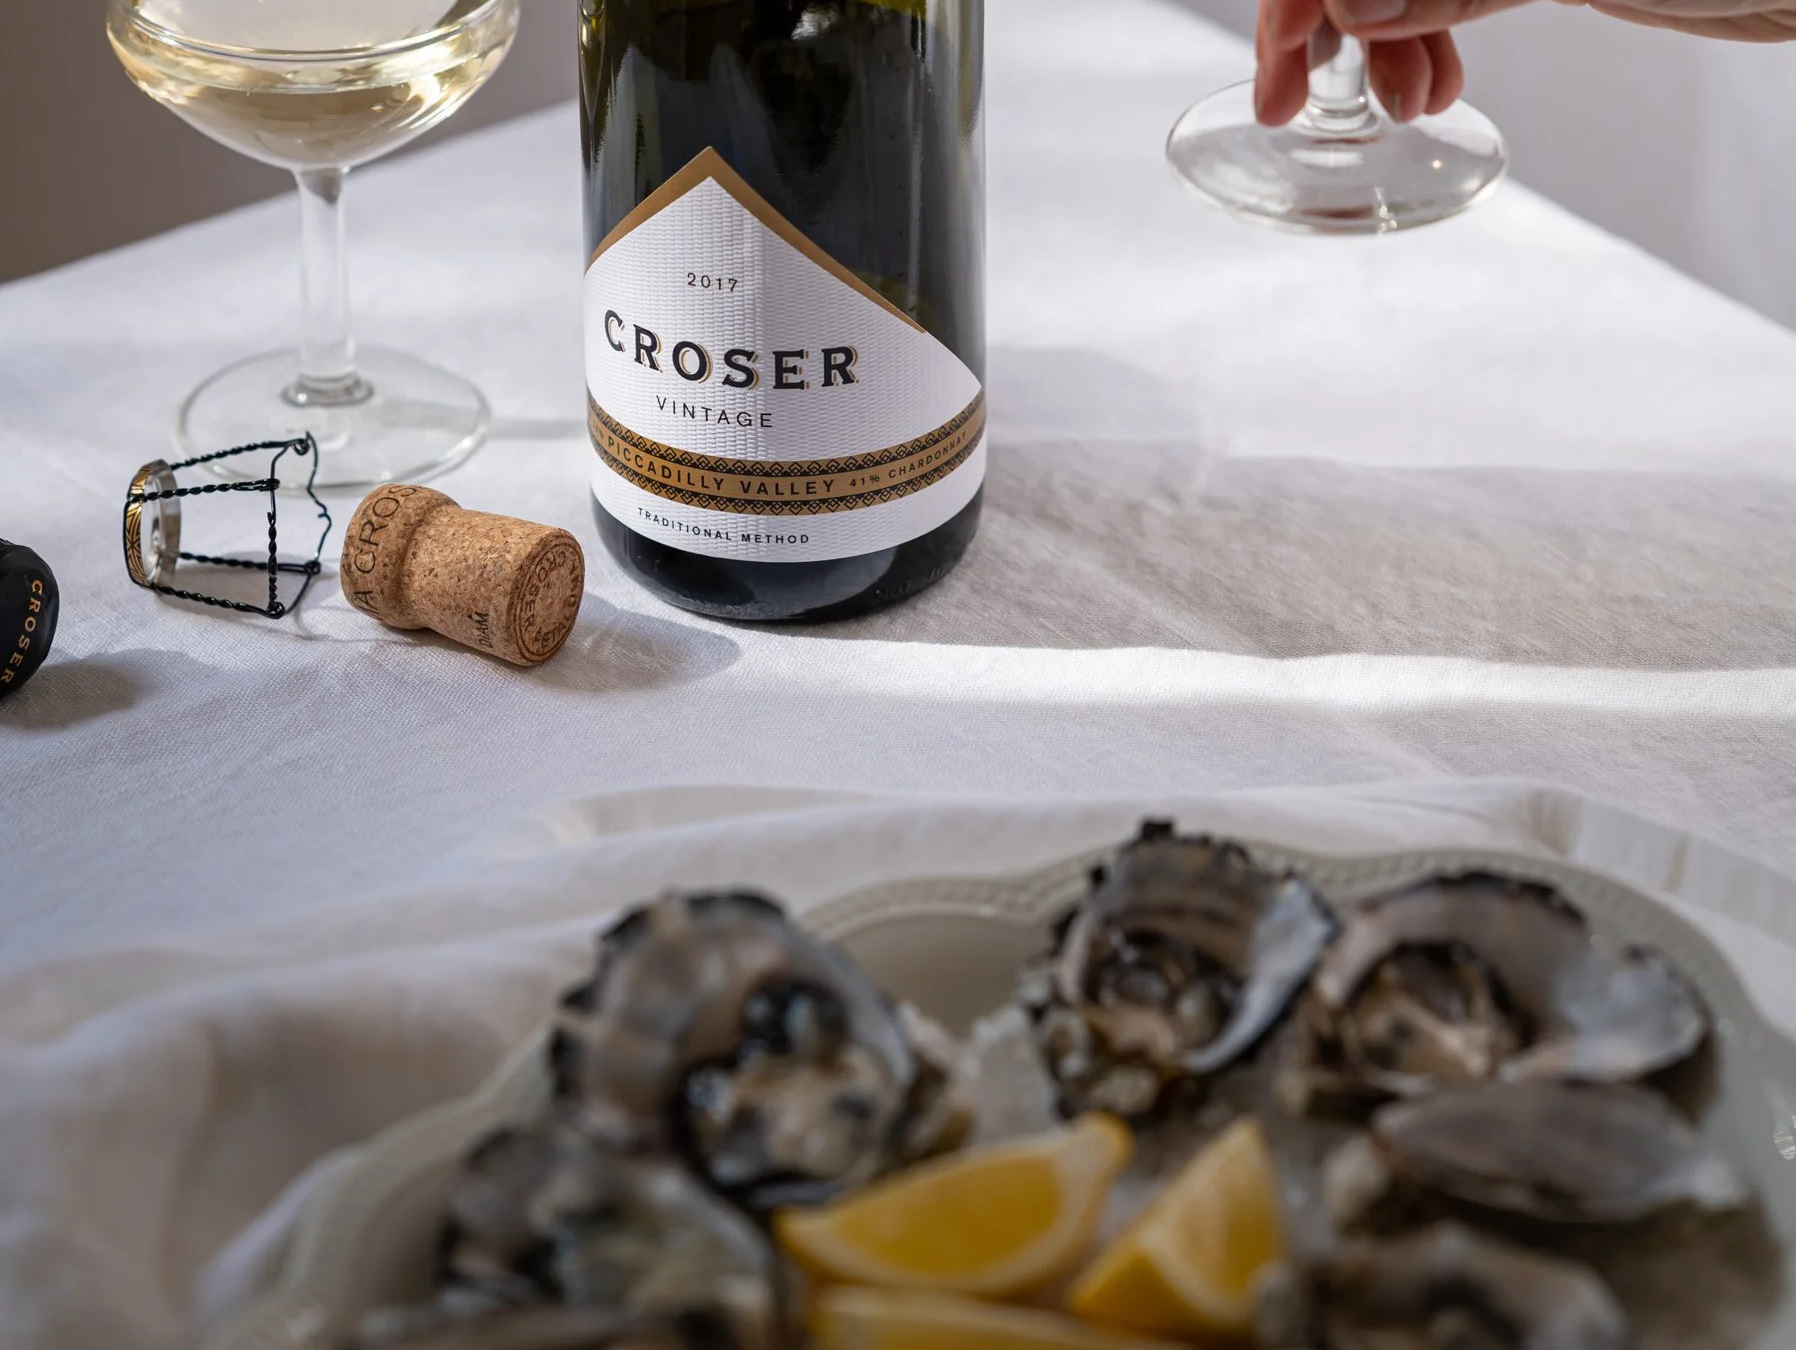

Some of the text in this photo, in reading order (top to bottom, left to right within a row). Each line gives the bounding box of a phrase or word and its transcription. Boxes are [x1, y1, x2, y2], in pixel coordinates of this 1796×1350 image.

[686, 272, 738, 293] 2017
[604, 309, 859, 391] CROSER
[656, 395, 773, 429] VINTAGE
[608, 432, 967, 496] PICCADILLY VALLEY 41% CHARDONNAY
[354, 486, 418, 574] CROS
[637, 507, 810, 545] TRADITIONAL METHOD
[0, 579, 43, 684] CROSER
[474, 611, 494, 649] DIAM
